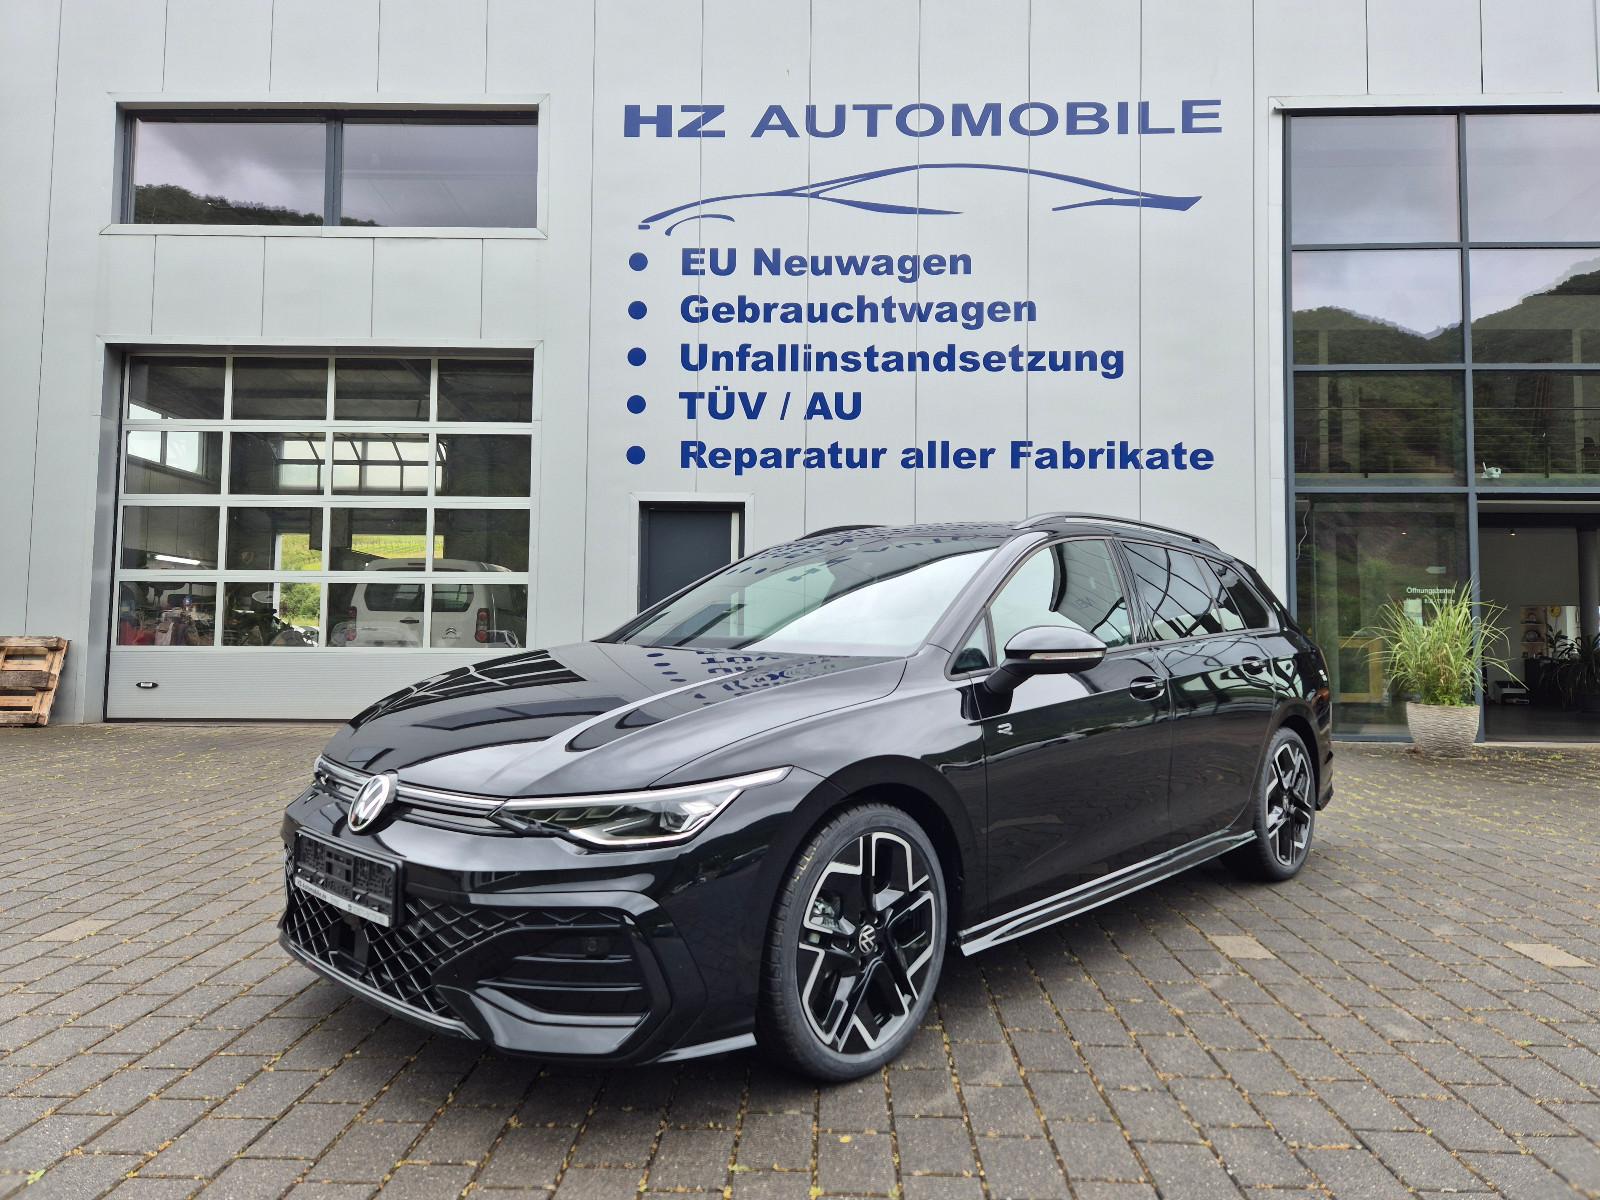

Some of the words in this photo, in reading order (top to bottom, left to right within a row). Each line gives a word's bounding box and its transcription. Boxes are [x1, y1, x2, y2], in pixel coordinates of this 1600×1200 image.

[624, 104, 726, 139] HZ
[751, 99, 1222, 139] AUTOMOBILE
[682, 248, 737, 277] EU
[753, 248, 972, 284] Neuwagen
[680, 295, 1037, 330] Gebrauchtwagen
[680, 343, 1125, 380] Unfallinstandsetzung
[679, 386, 768, 421] TÜV
[780, 393, 791, 420] /
[804, 392, 863, 421] AU
[680, 440, 887, 477] Reparatur
[899, 440, 997, 470] aller
[1009, 440, 1215, 471] Fabrikate
